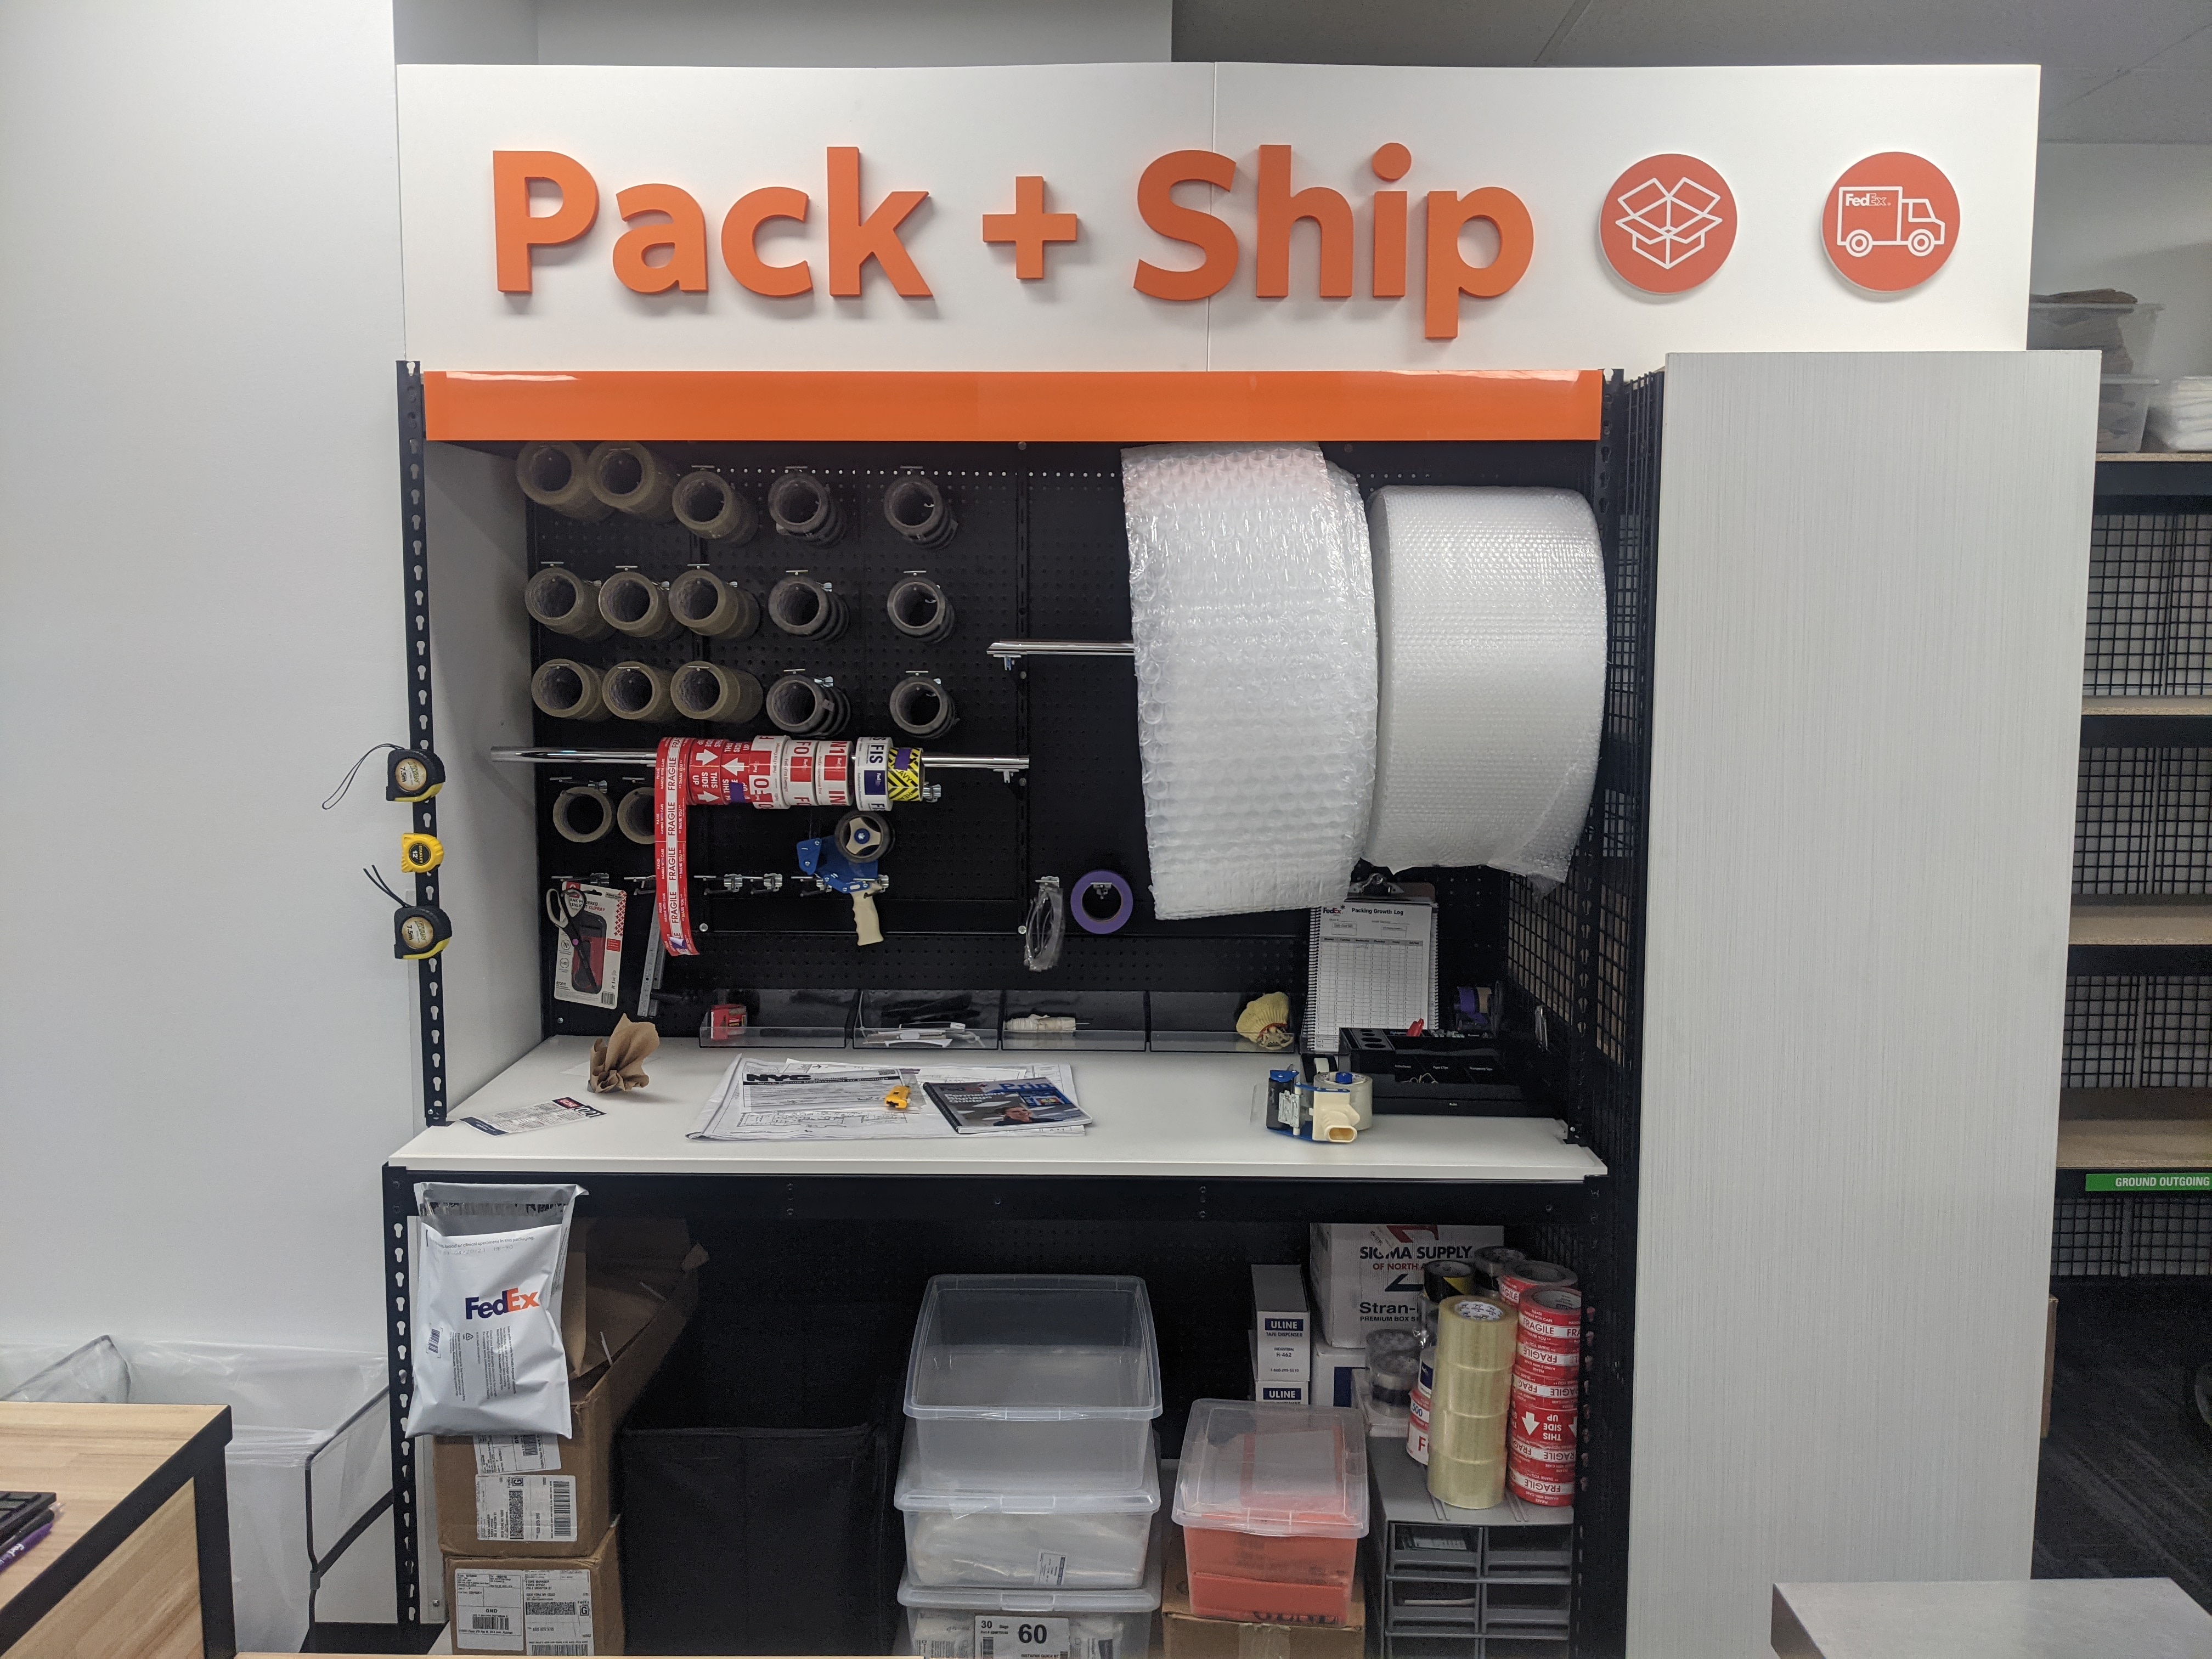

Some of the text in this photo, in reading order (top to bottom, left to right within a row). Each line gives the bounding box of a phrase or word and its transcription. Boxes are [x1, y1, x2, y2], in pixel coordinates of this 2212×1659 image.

[1846, 193, 1887, 206] FedEx
[493, 143, 1534, 339] Pack + Ship
[794, 742, 811, 754] FO
[830, 741, 847, 753] N1
[870, 745, 884, 764] FIS
[668, 757, 676, 791] FRAGILE
[692, 775, 699, 785] UP
[722, 778, 730, 794] THIS
[669, 891, 679, 923] FRAGILE
[999, 1082, 1054, 1092] Prin
[2115, 1177, 2210, 1187] GROUND OUTGOING
[1360, 1246, 1472, 1259] SIGMA SUPPLY
[465, 1287, 540, 1319] FedEx
[1360, 1302, 1419, 1314] Stran-
[1271, 1321, 1297, 1329] ULINE
[1523, 1317, 1554, 1335] FRAGILE
[1523, 1347, 1558, 1363] FRAGILE
[1269, 1390, 1296, 1398] ULINE
[1550, 1386, 1577, 1396] AGILE
[1412, 1403, 1423, 1417] 500
[1547, 1414, 1559, 1422] UP
[1543, 1423, 1562, 1431] SIDE
[1543, 1432, 1561, 1441] THIS
[1514, 1440, 1532, 1455] FRAG
[1543, 1452, 1575, 1460] RAGILE
[1524, 1479, 1561, 1493] FRAGILE
[581, 1606, 588, 1615] G
[981, 1620, 992, 1629] 30
[1018, 1624, 1047, 1644] 60
